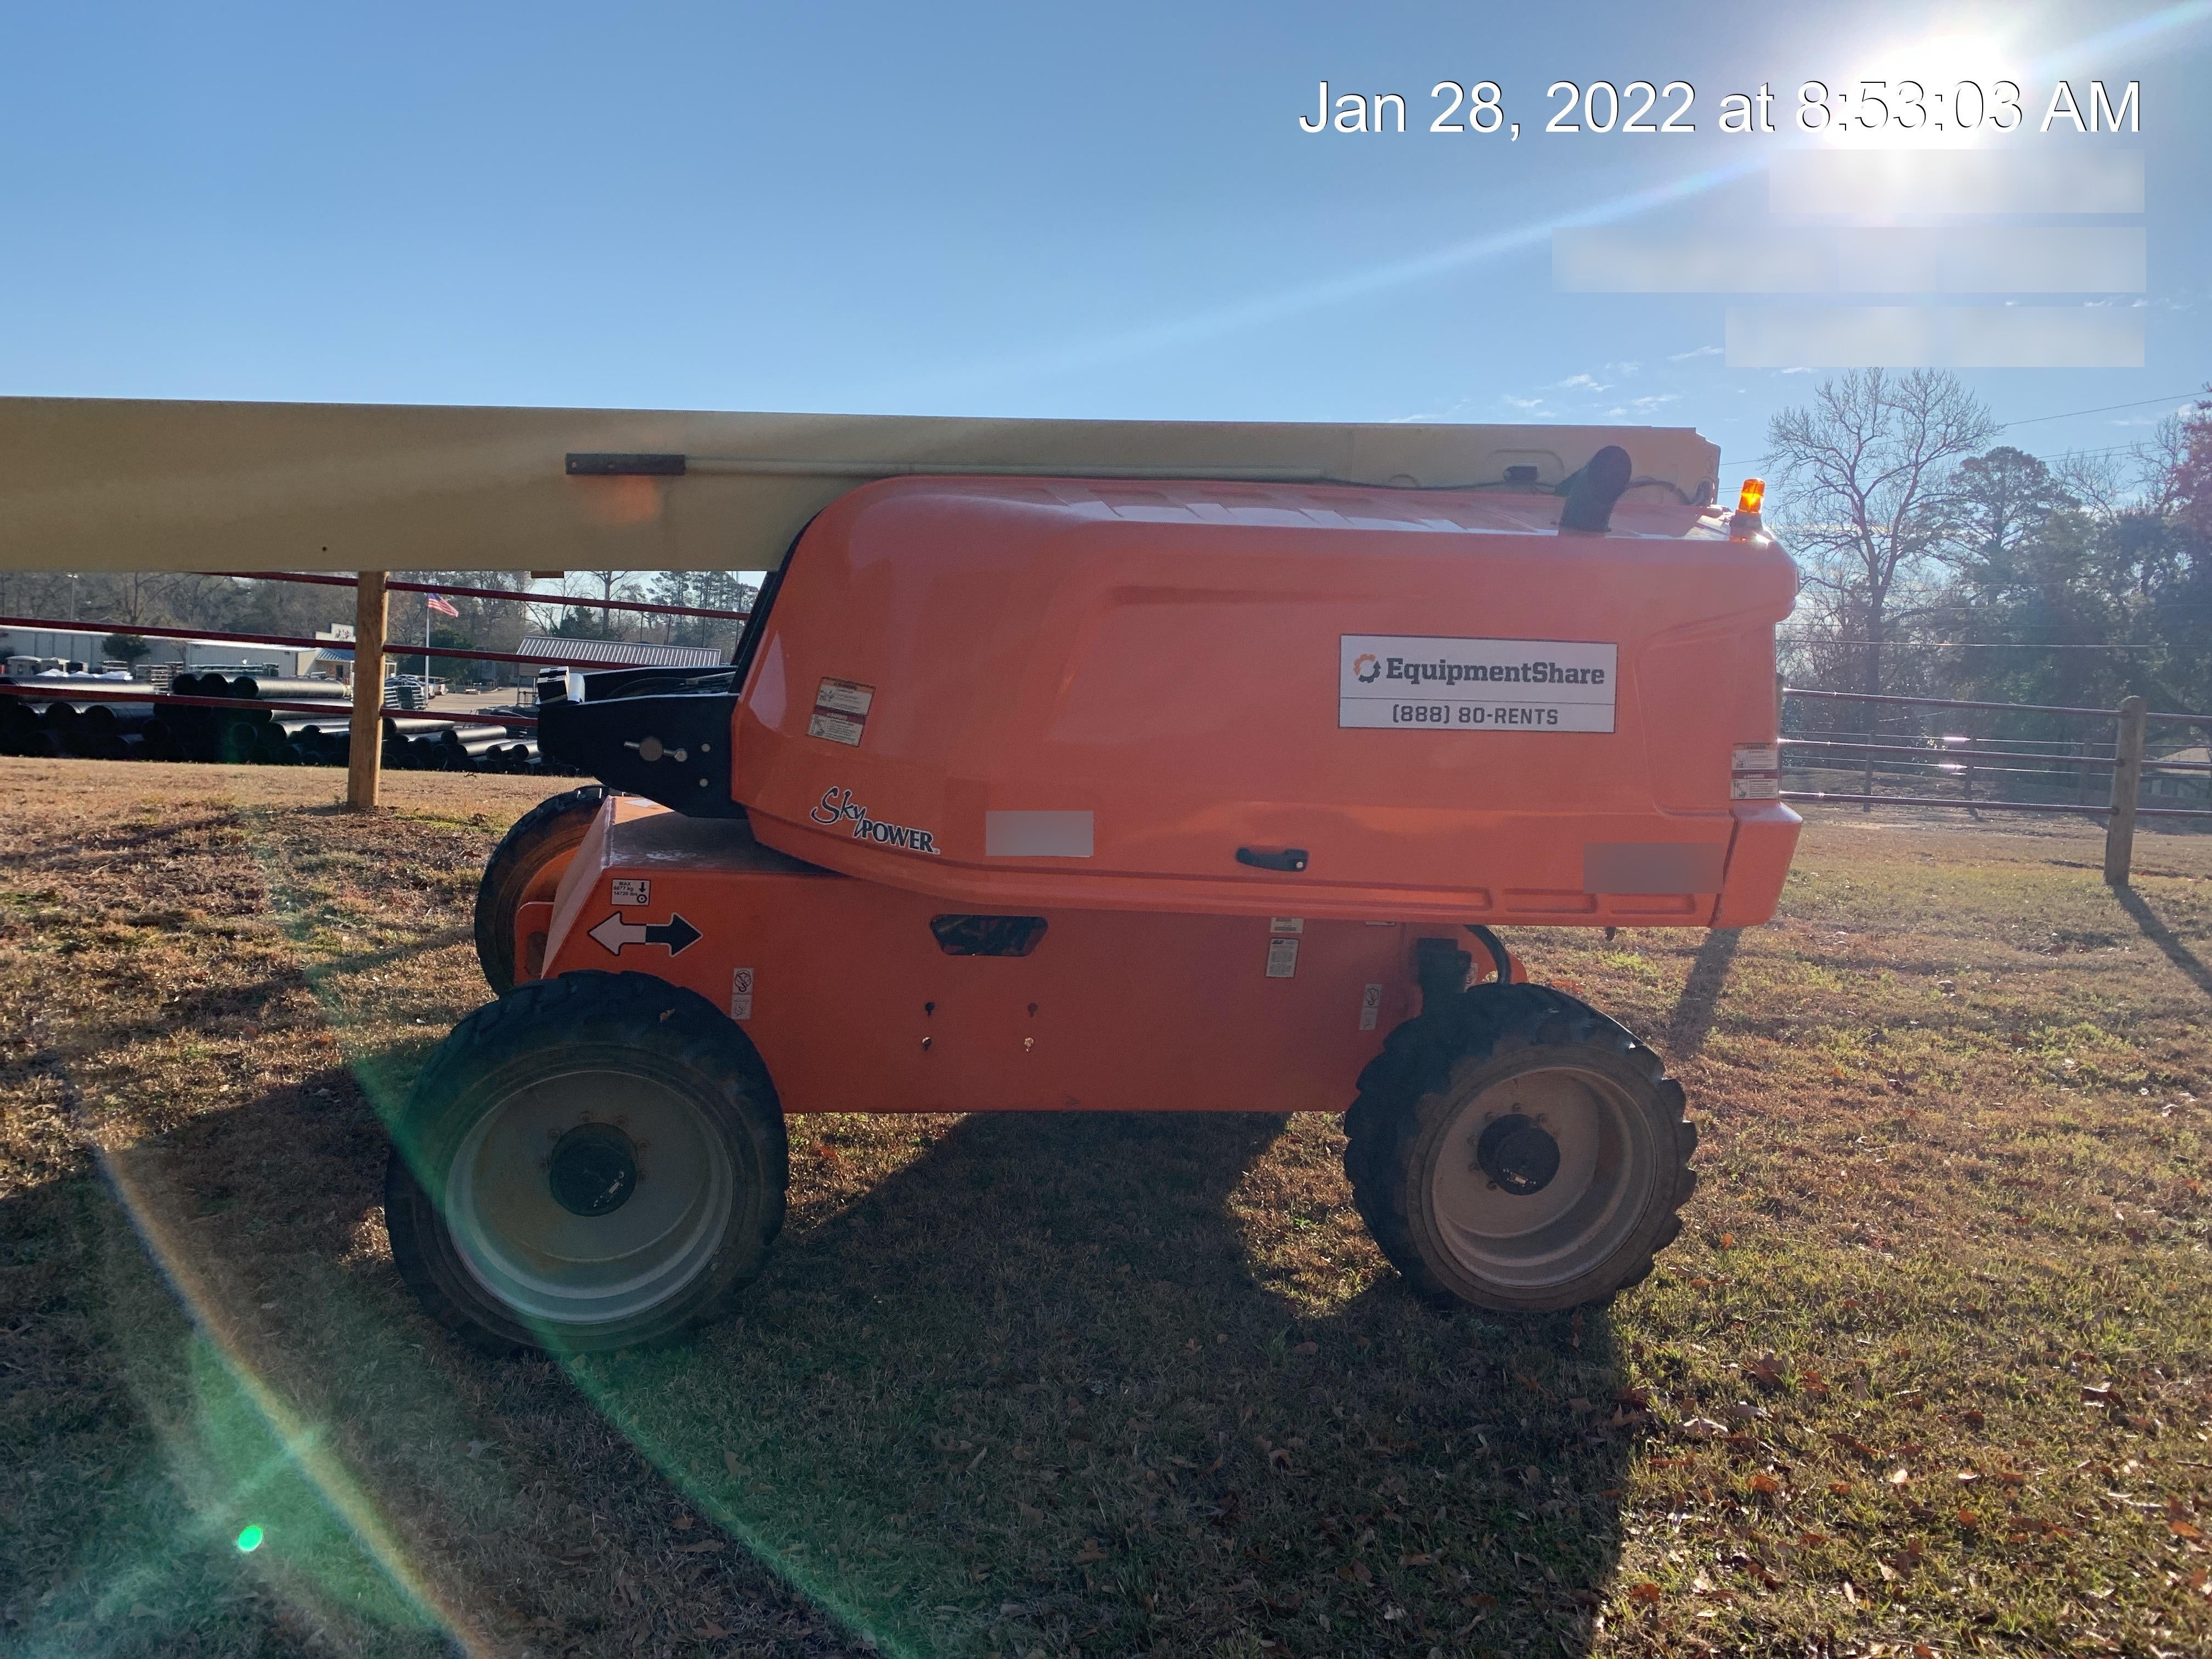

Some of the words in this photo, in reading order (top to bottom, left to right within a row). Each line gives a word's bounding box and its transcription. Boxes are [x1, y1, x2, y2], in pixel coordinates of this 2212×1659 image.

[1386, 657, 1605, 685] EquipmentShare
[1392, 704, 1450, 724] (888)
[1458, 706, 1559, 725] 80-RENTS
[810, 786, 867, 838] Sky
[861, 819, 935, 853] POWER
